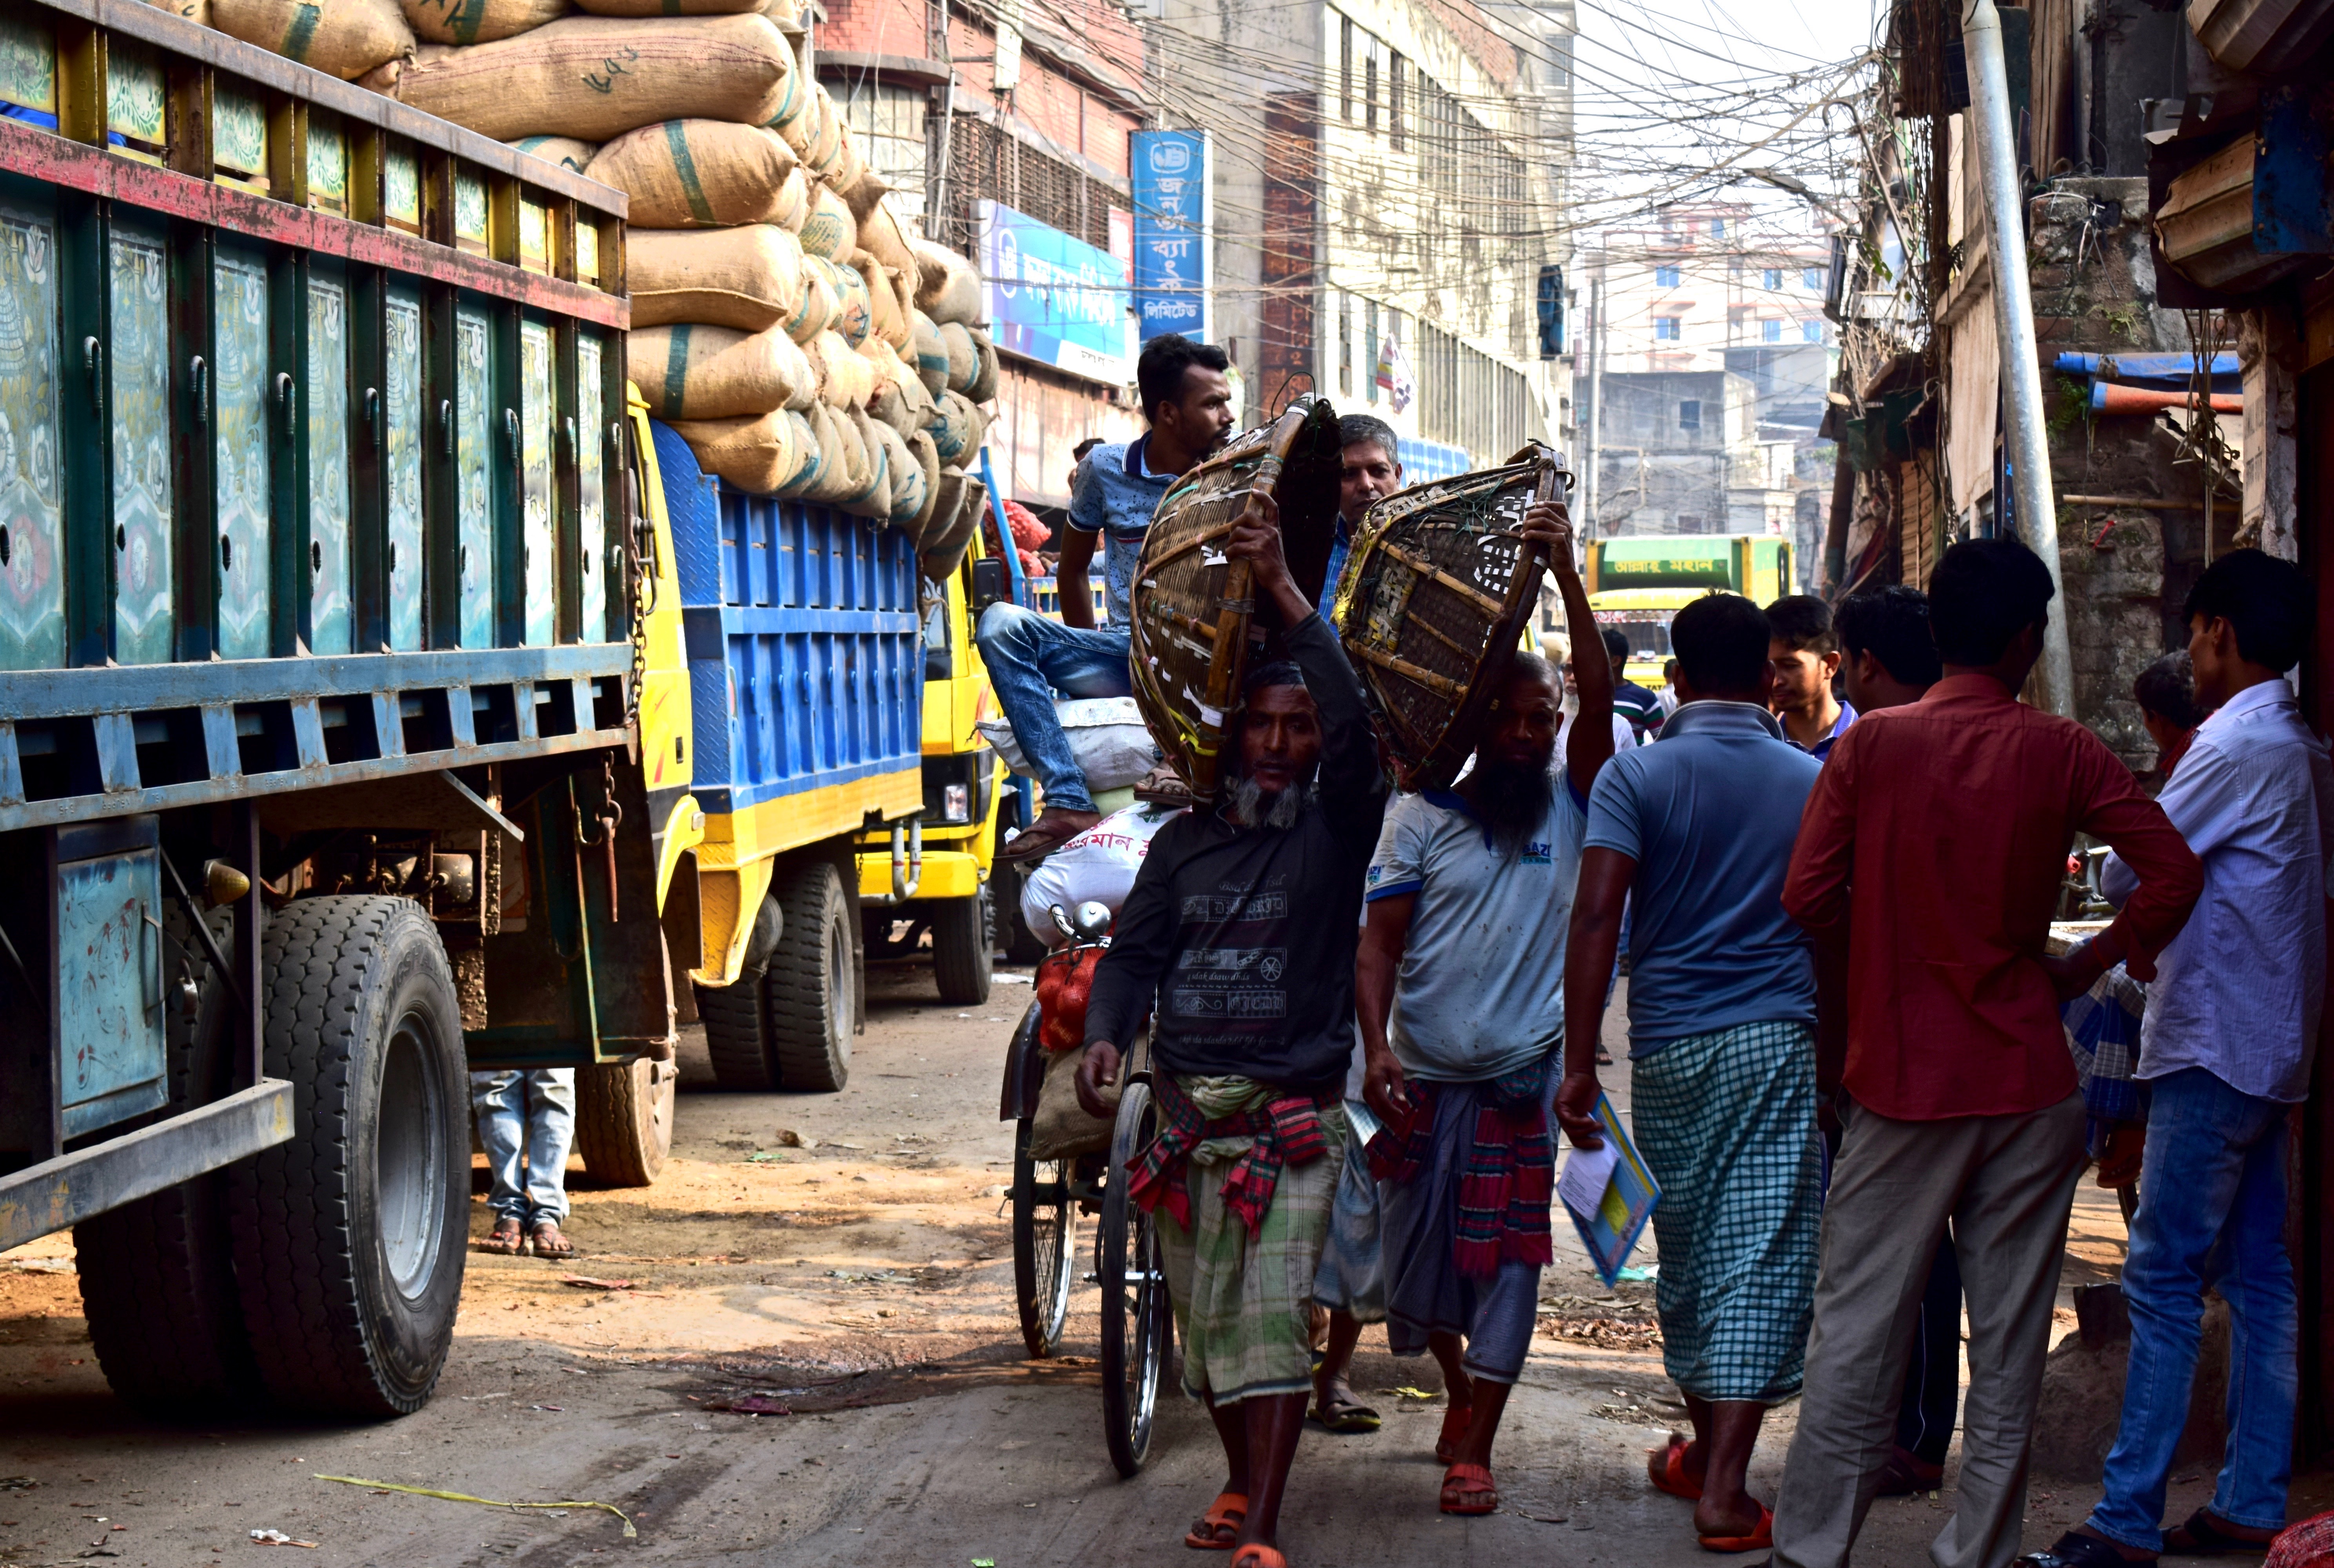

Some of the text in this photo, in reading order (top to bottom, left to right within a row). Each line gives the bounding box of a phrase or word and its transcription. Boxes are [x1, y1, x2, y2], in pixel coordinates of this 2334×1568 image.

[1149, 177, 1190, 295] জনতা ব্যাংক
[1144, 301, 1197, 319] লিমিটেড
[1669, 560, 1713, 573] মহান
[1523, 842, 1550, 857] GAZI
